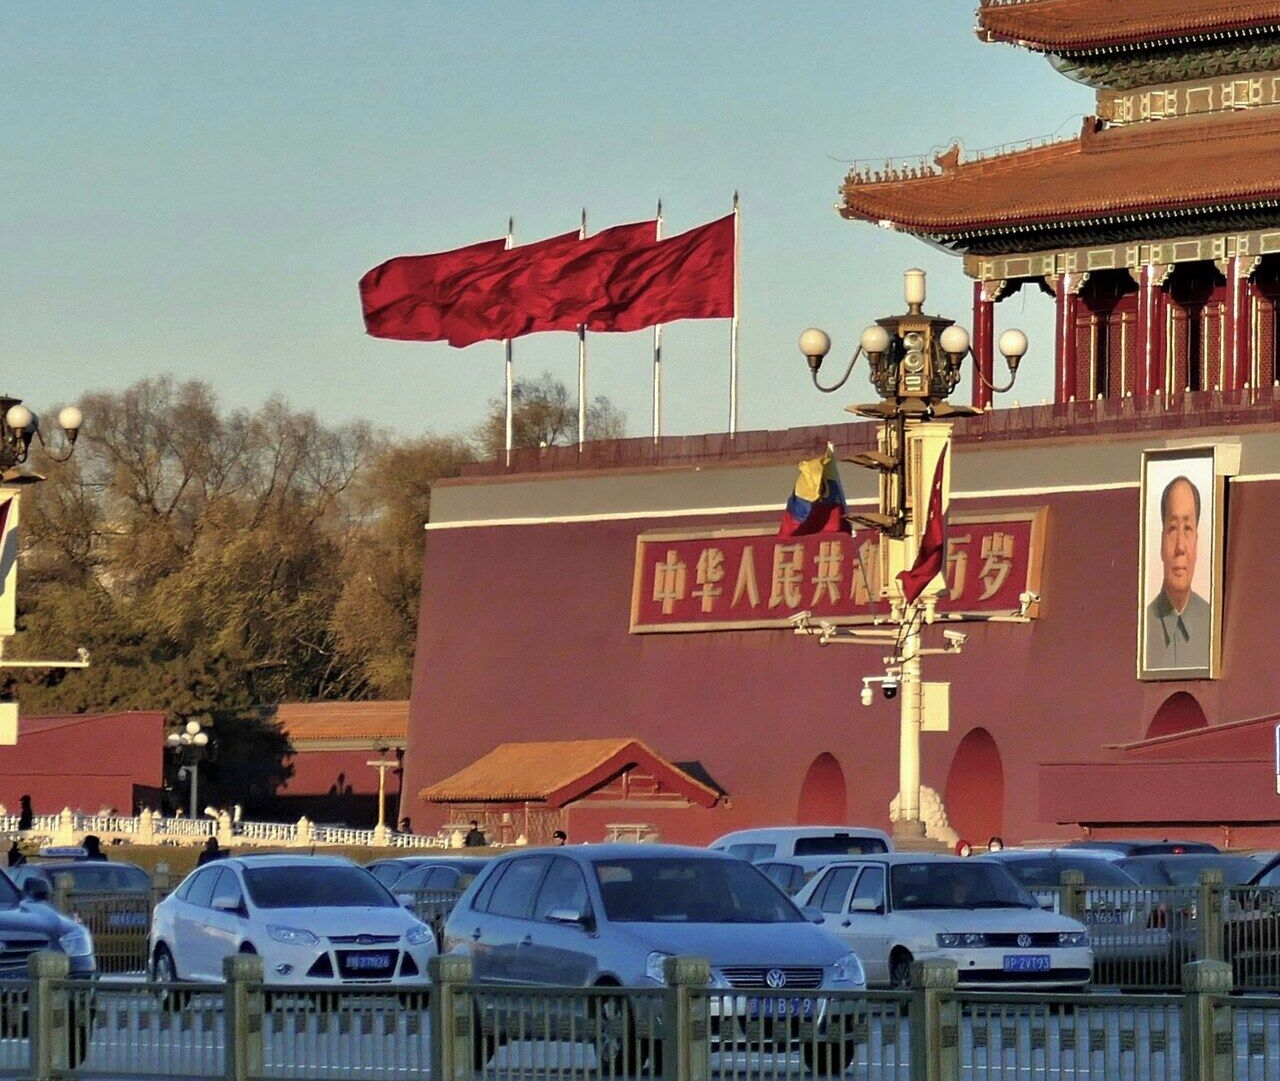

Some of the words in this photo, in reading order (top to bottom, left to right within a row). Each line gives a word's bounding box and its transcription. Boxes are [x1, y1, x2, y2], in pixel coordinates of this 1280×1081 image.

[652, 531, 1014, 615] 中华人民共和万岁
